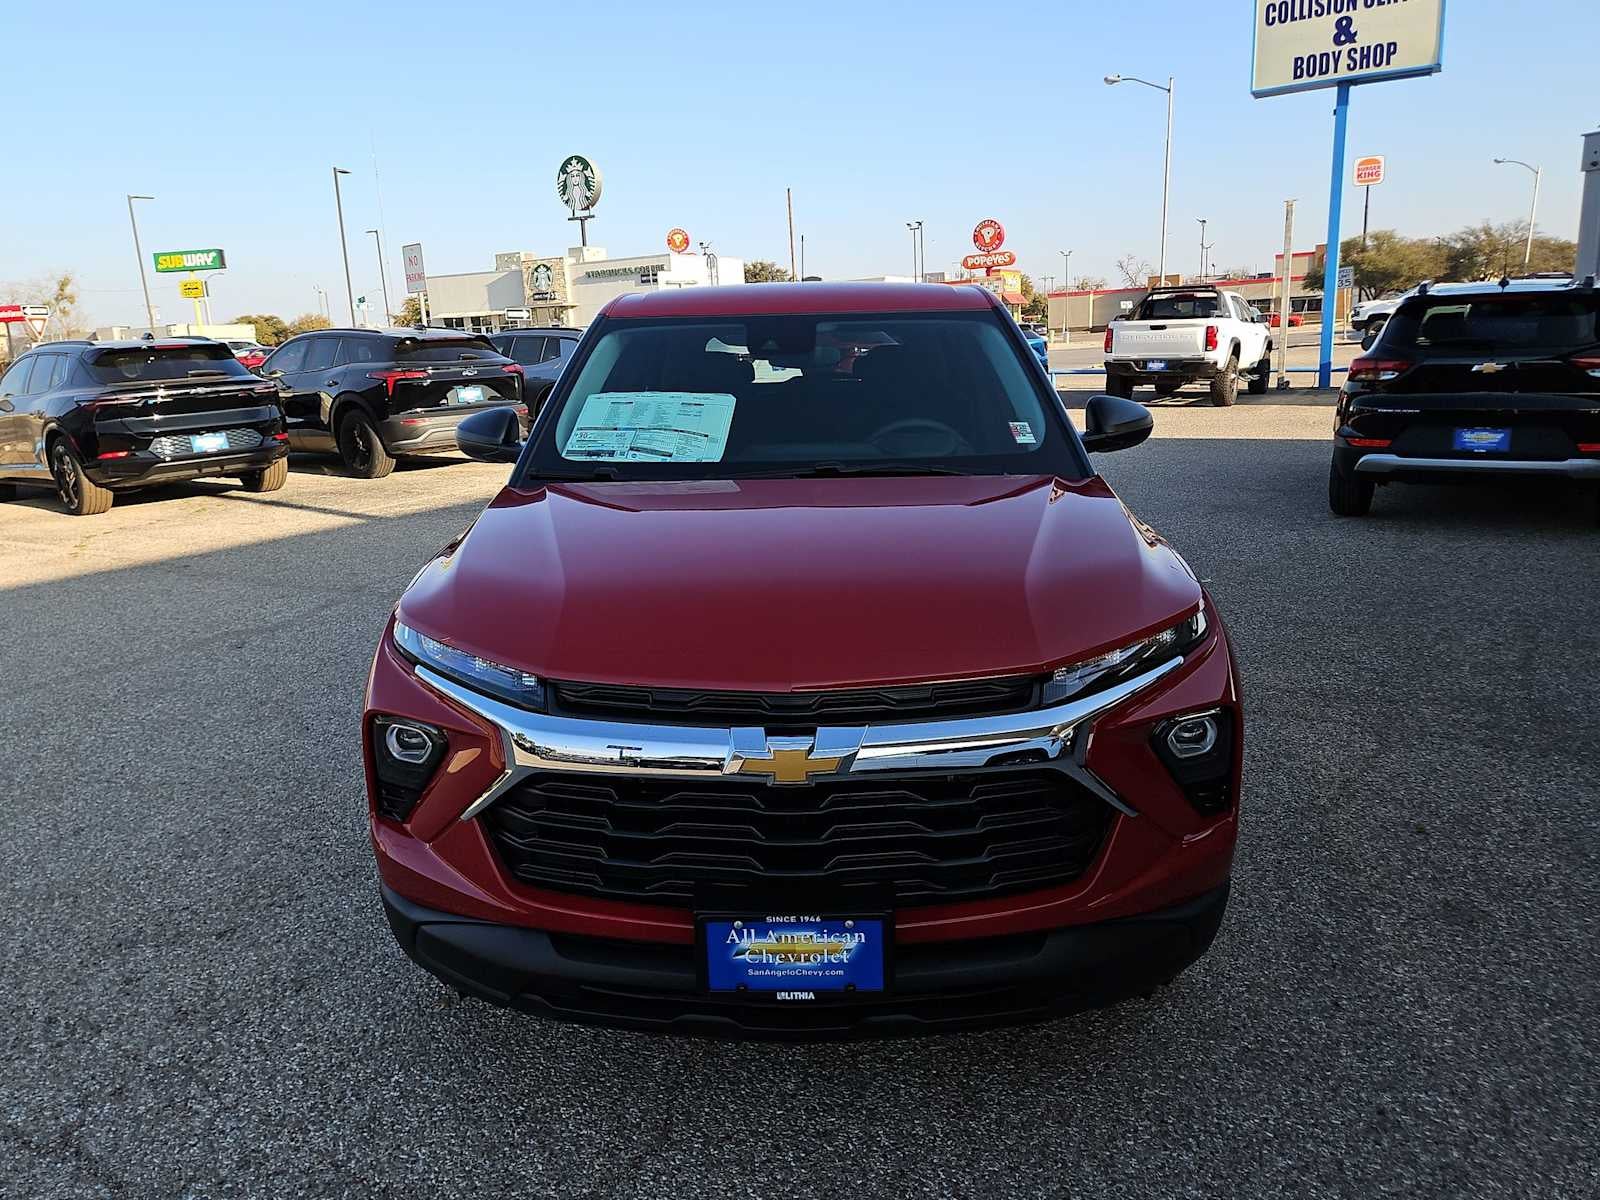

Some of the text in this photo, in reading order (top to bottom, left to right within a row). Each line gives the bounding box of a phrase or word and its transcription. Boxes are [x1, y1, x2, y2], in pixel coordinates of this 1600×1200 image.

[1265, 0, 1358, 27] COLLISION
[1332, 15, 1358, 46] &
[1293, 41, 1398, 80] BODY SHOP
[1357, 170, 1381, 179] KING
[158, 251, 217, 270] SUBWAY
[408, 255, 418, 267] NO
[406, 271, 425, 282] PARKING
[1337, 278, 1352, 288] 35
[765, 915, 797, 923] SINCE
[725, 928, 867, 944] All American
[745, 949, 850, 964] Chevrolet
[747, 968, 845, 977] SanAngeloChevy.com
[785, 991, 816, 1000] LITHIA
